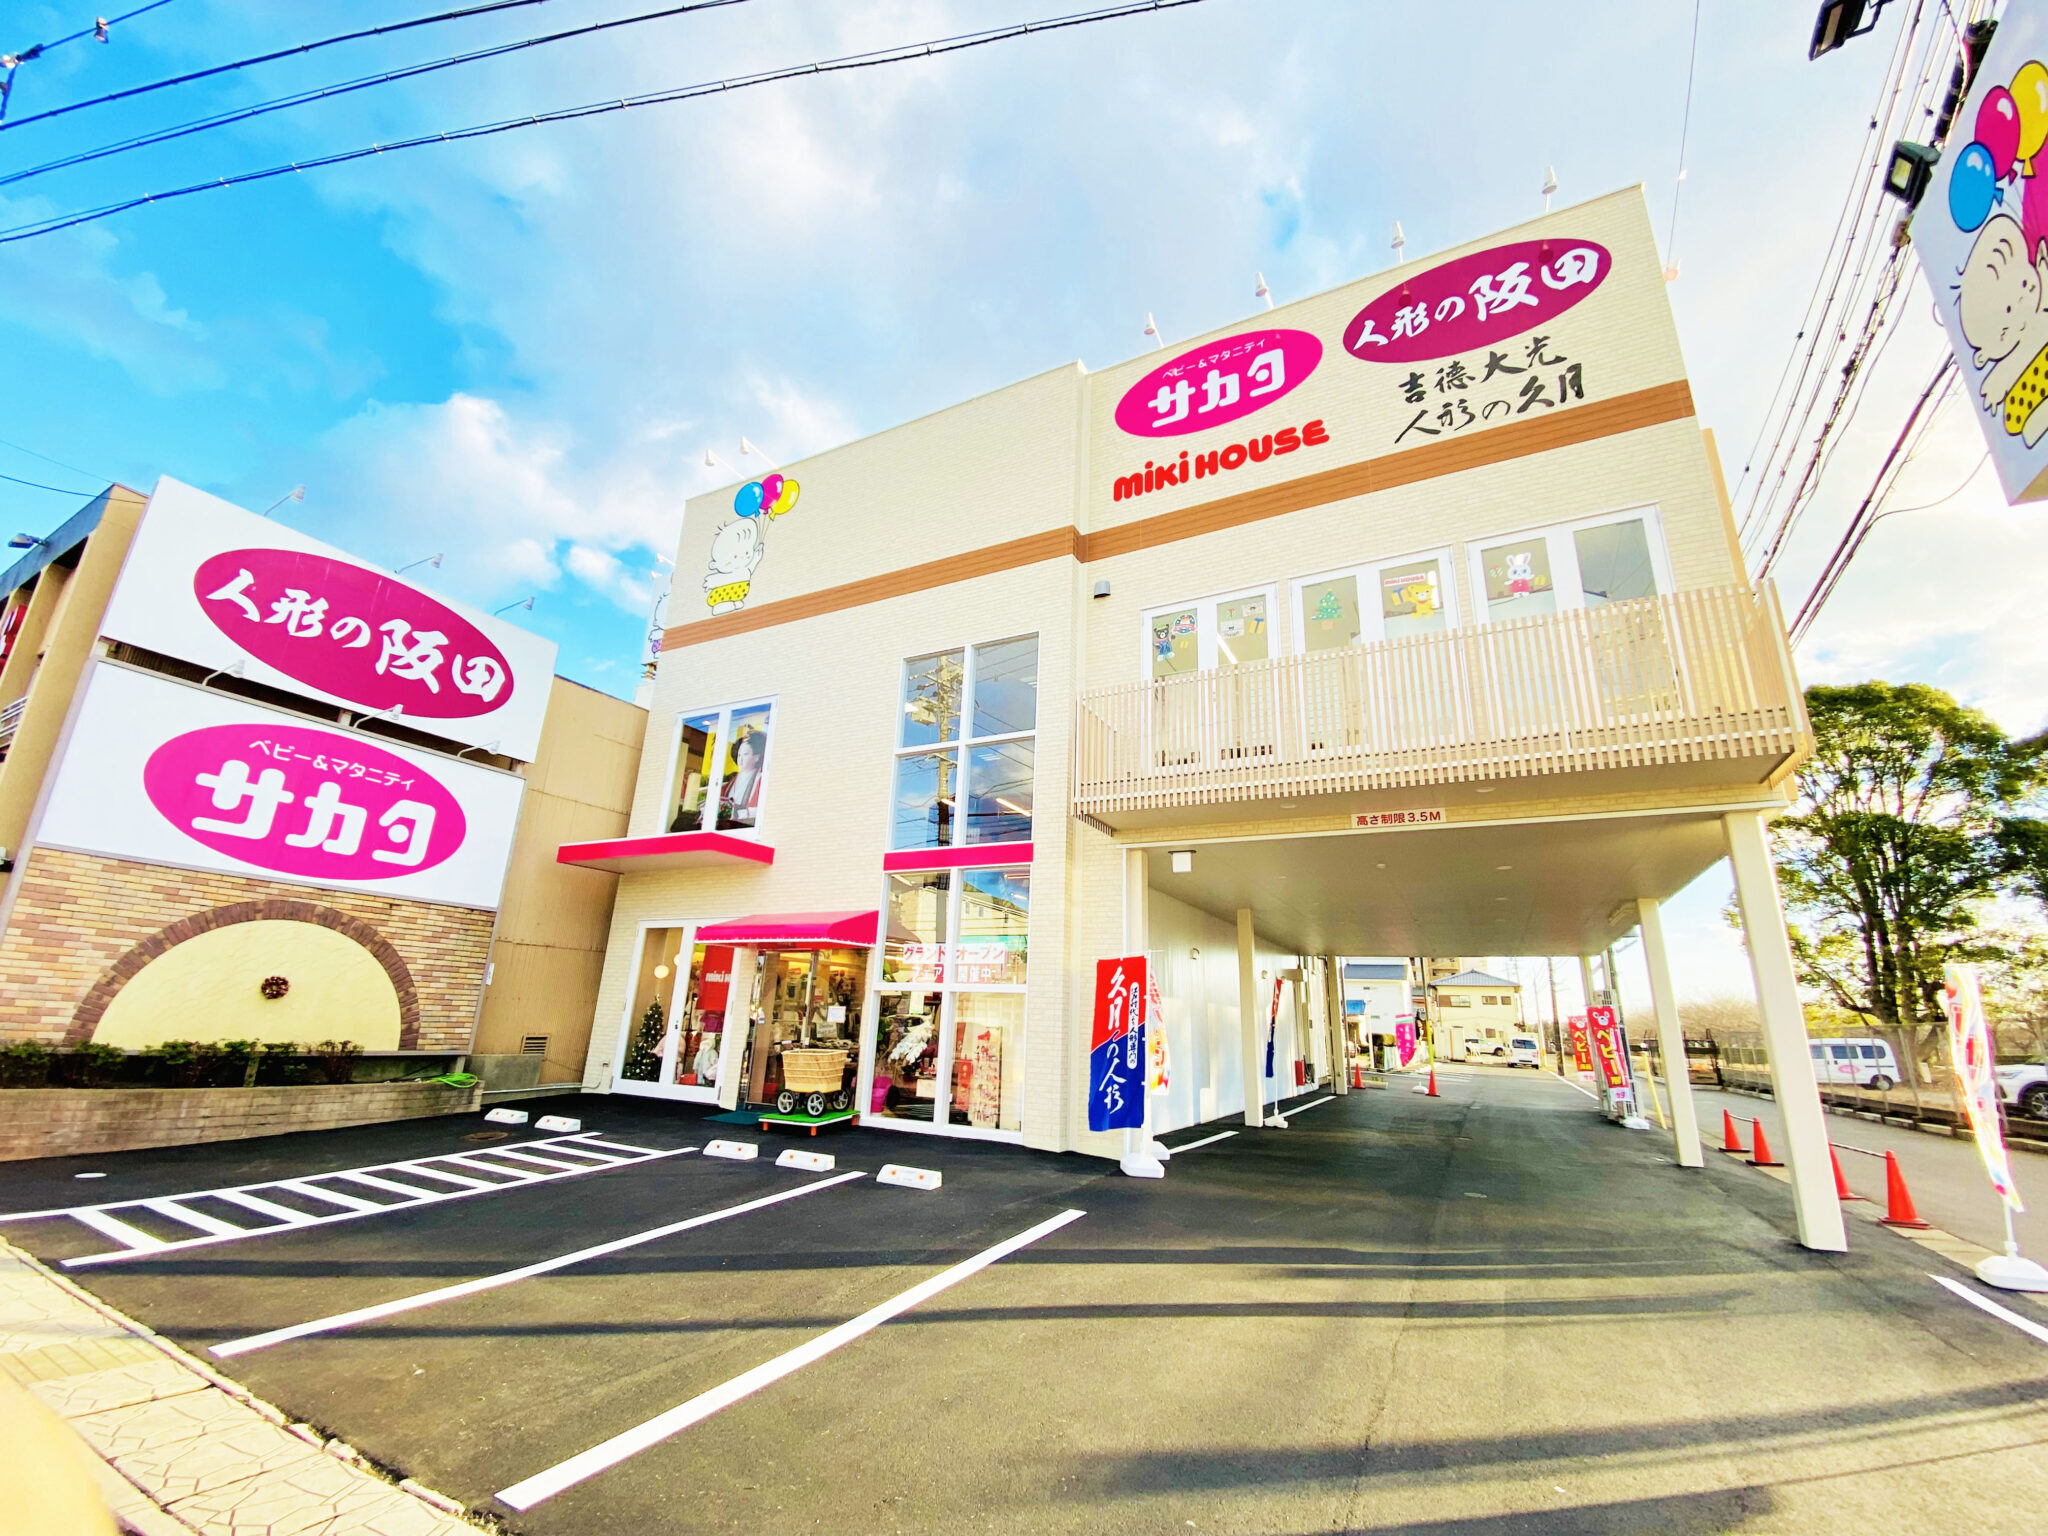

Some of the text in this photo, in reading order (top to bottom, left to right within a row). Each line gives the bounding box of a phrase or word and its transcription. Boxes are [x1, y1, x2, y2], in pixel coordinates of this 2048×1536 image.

[1353, 248, 1600, 351] 人形の阪田
[1148, 349, 1286, 428] サカタ
[1394, 363, 1585, 444] 人形の久月
[1113, 419, 1330, 501] miki HOUSE
[207, 568, 506, 703] 人形の阪田
[191, 760, 436, 867] サカタ
[1356, 811, 1441, 827] 高さ制限3.5M
